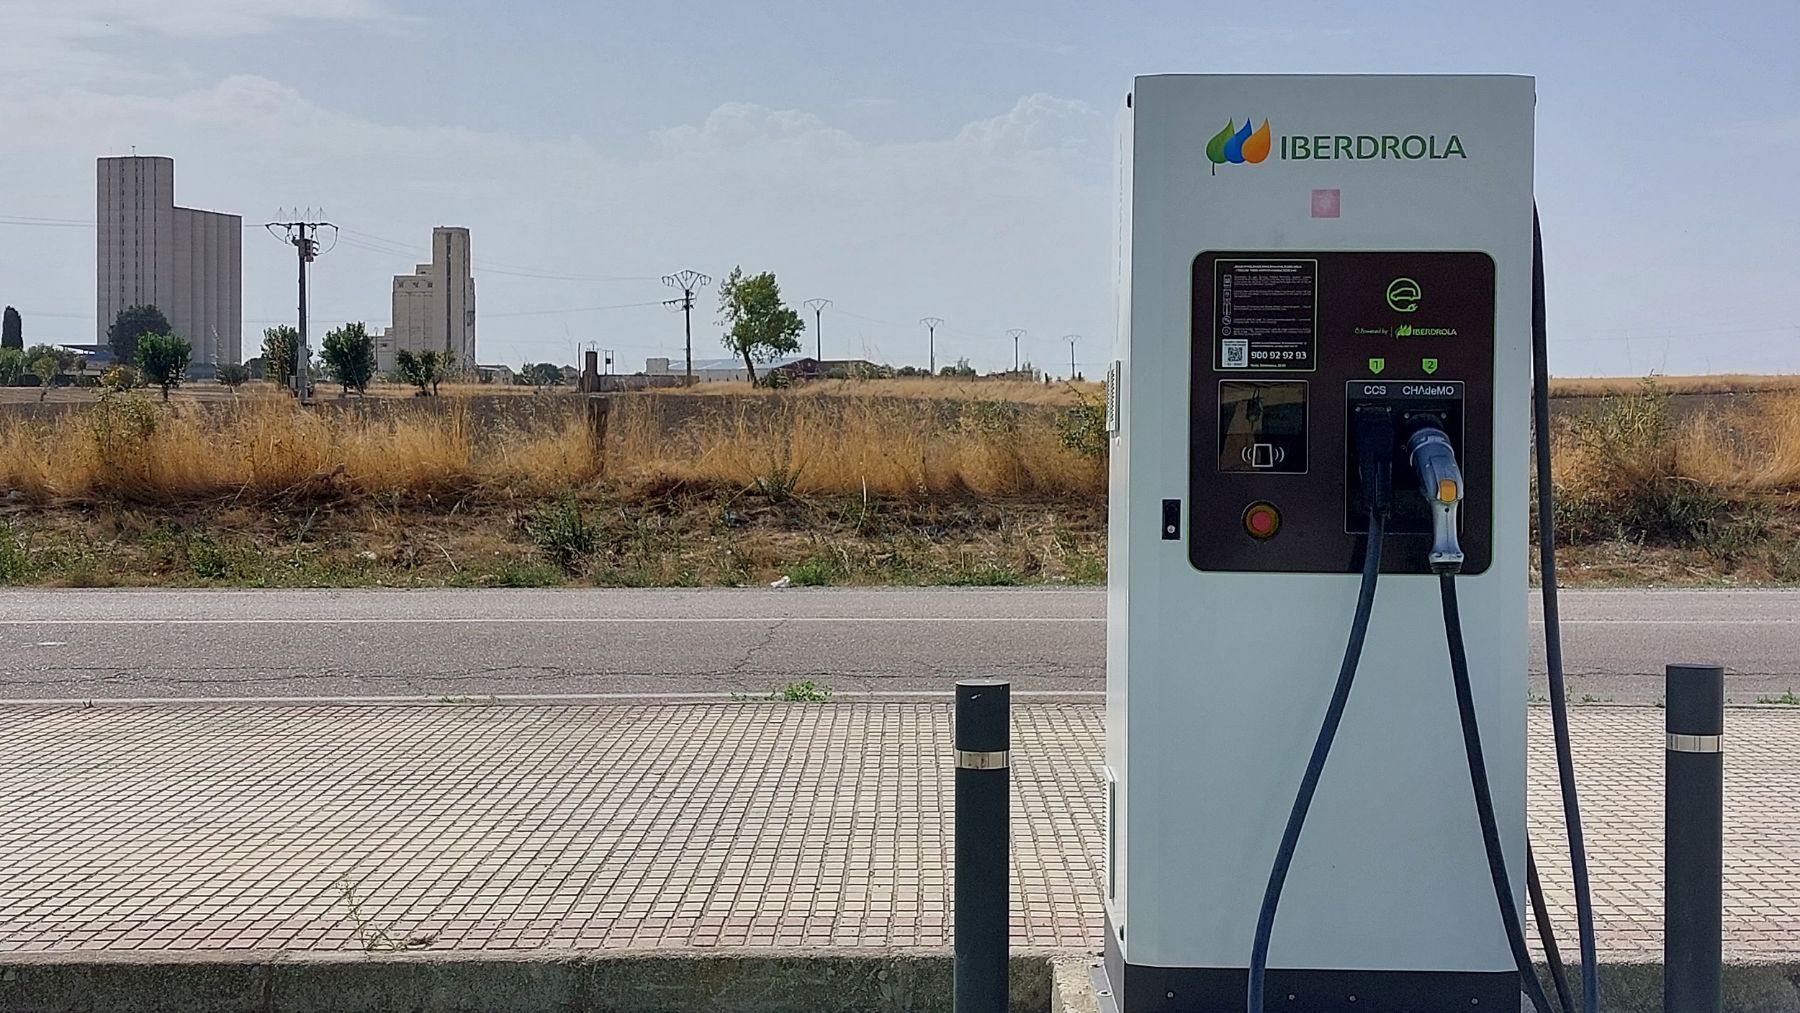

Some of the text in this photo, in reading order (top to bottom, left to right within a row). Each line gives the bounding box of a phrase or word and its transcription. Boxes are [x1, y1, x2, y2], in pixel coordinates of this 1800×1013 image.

[1281, 135, 1467, 160] IBERDROLA
[1412, 328, 1458, 336] IBERDROLA
[1251, 351, 1307, 360] 900 92 92 93
[1427, 361, 1434, 369] 2
[1364, 385, 1387, 395] CCS
[1402, 385, 1455, 395] CHAdeMO
